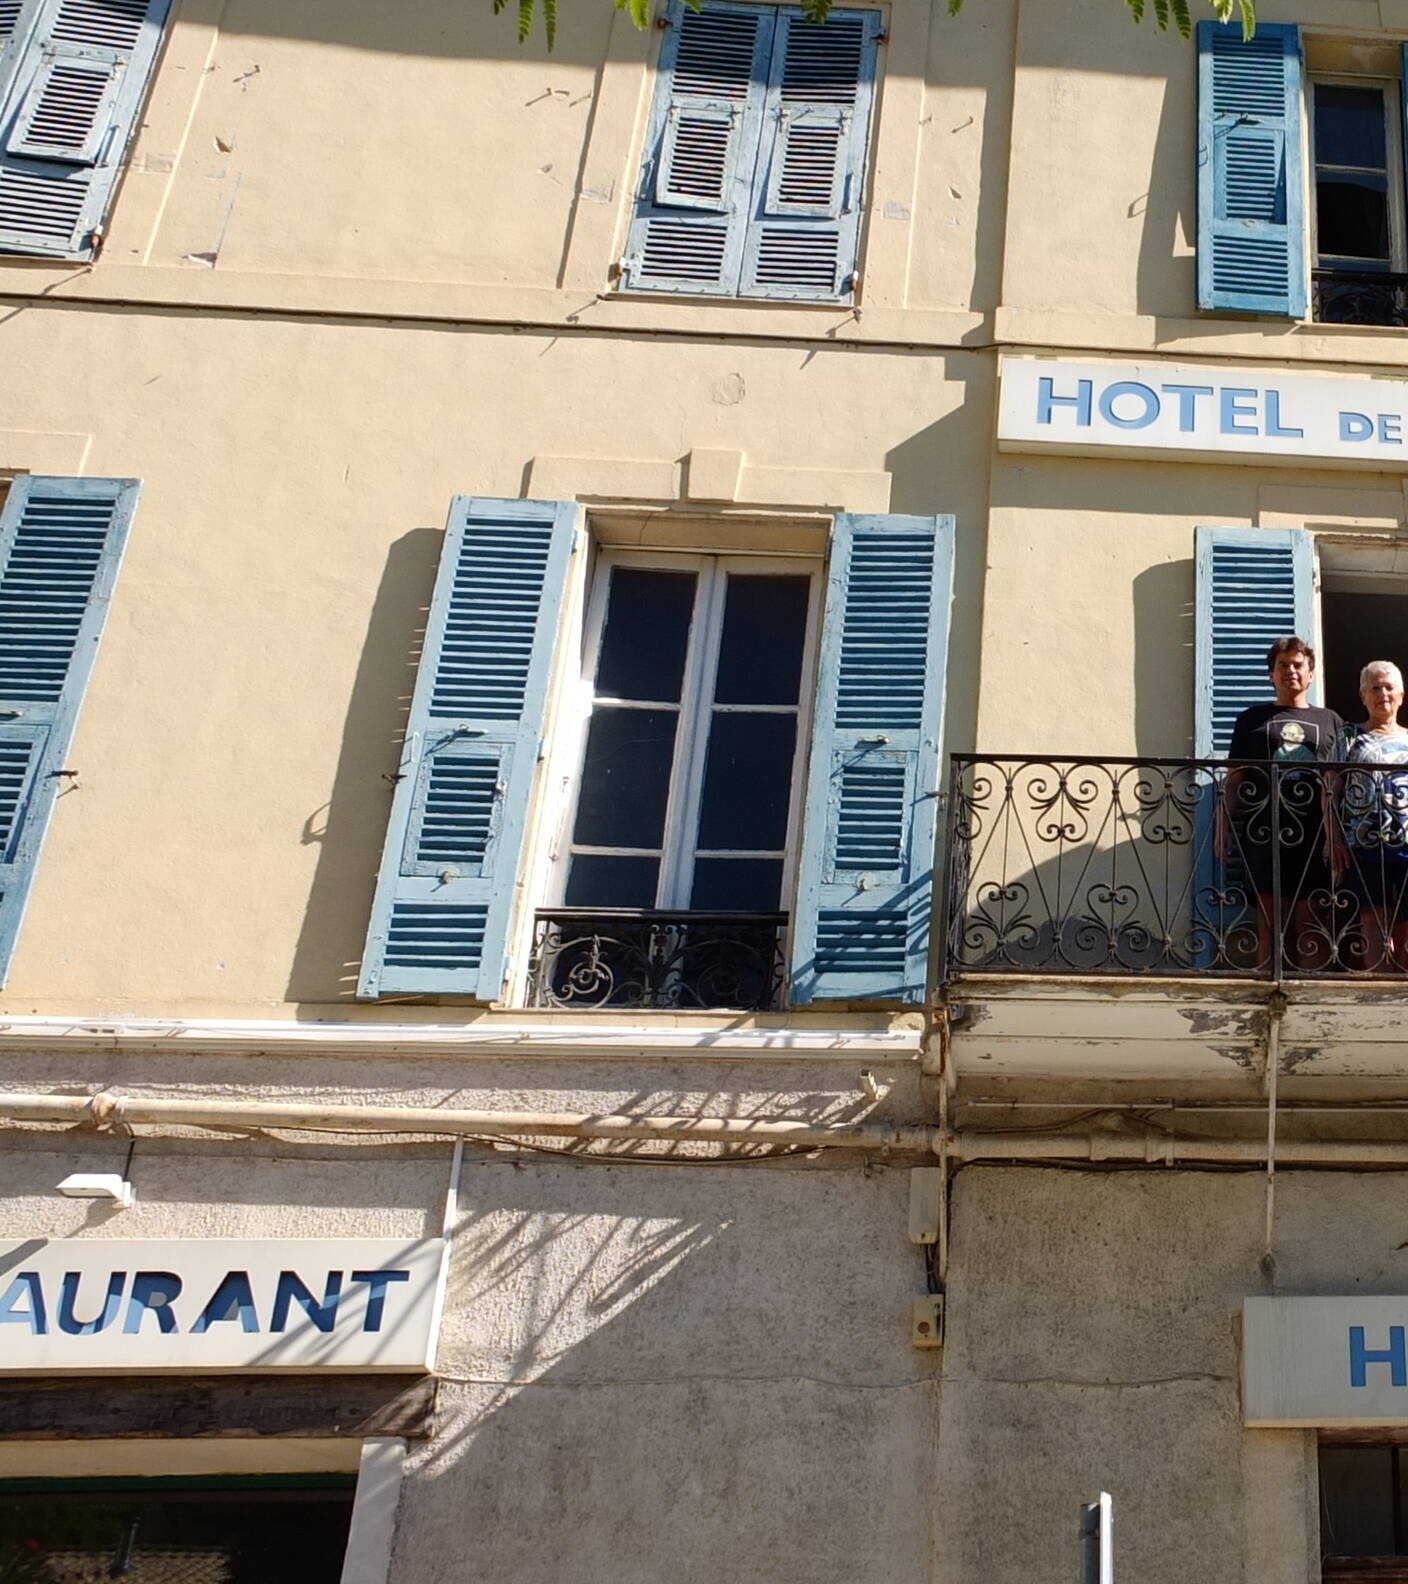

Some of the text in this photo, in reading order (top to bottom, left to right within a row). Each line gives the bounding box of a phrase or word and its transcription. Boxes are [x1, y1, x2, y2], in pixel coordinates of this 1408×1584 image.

[1036, 376, 1304, 439] HOTEL
[1338, 411, 1403, 444] DE
[0, 1269, 411, 1335] AURANT
